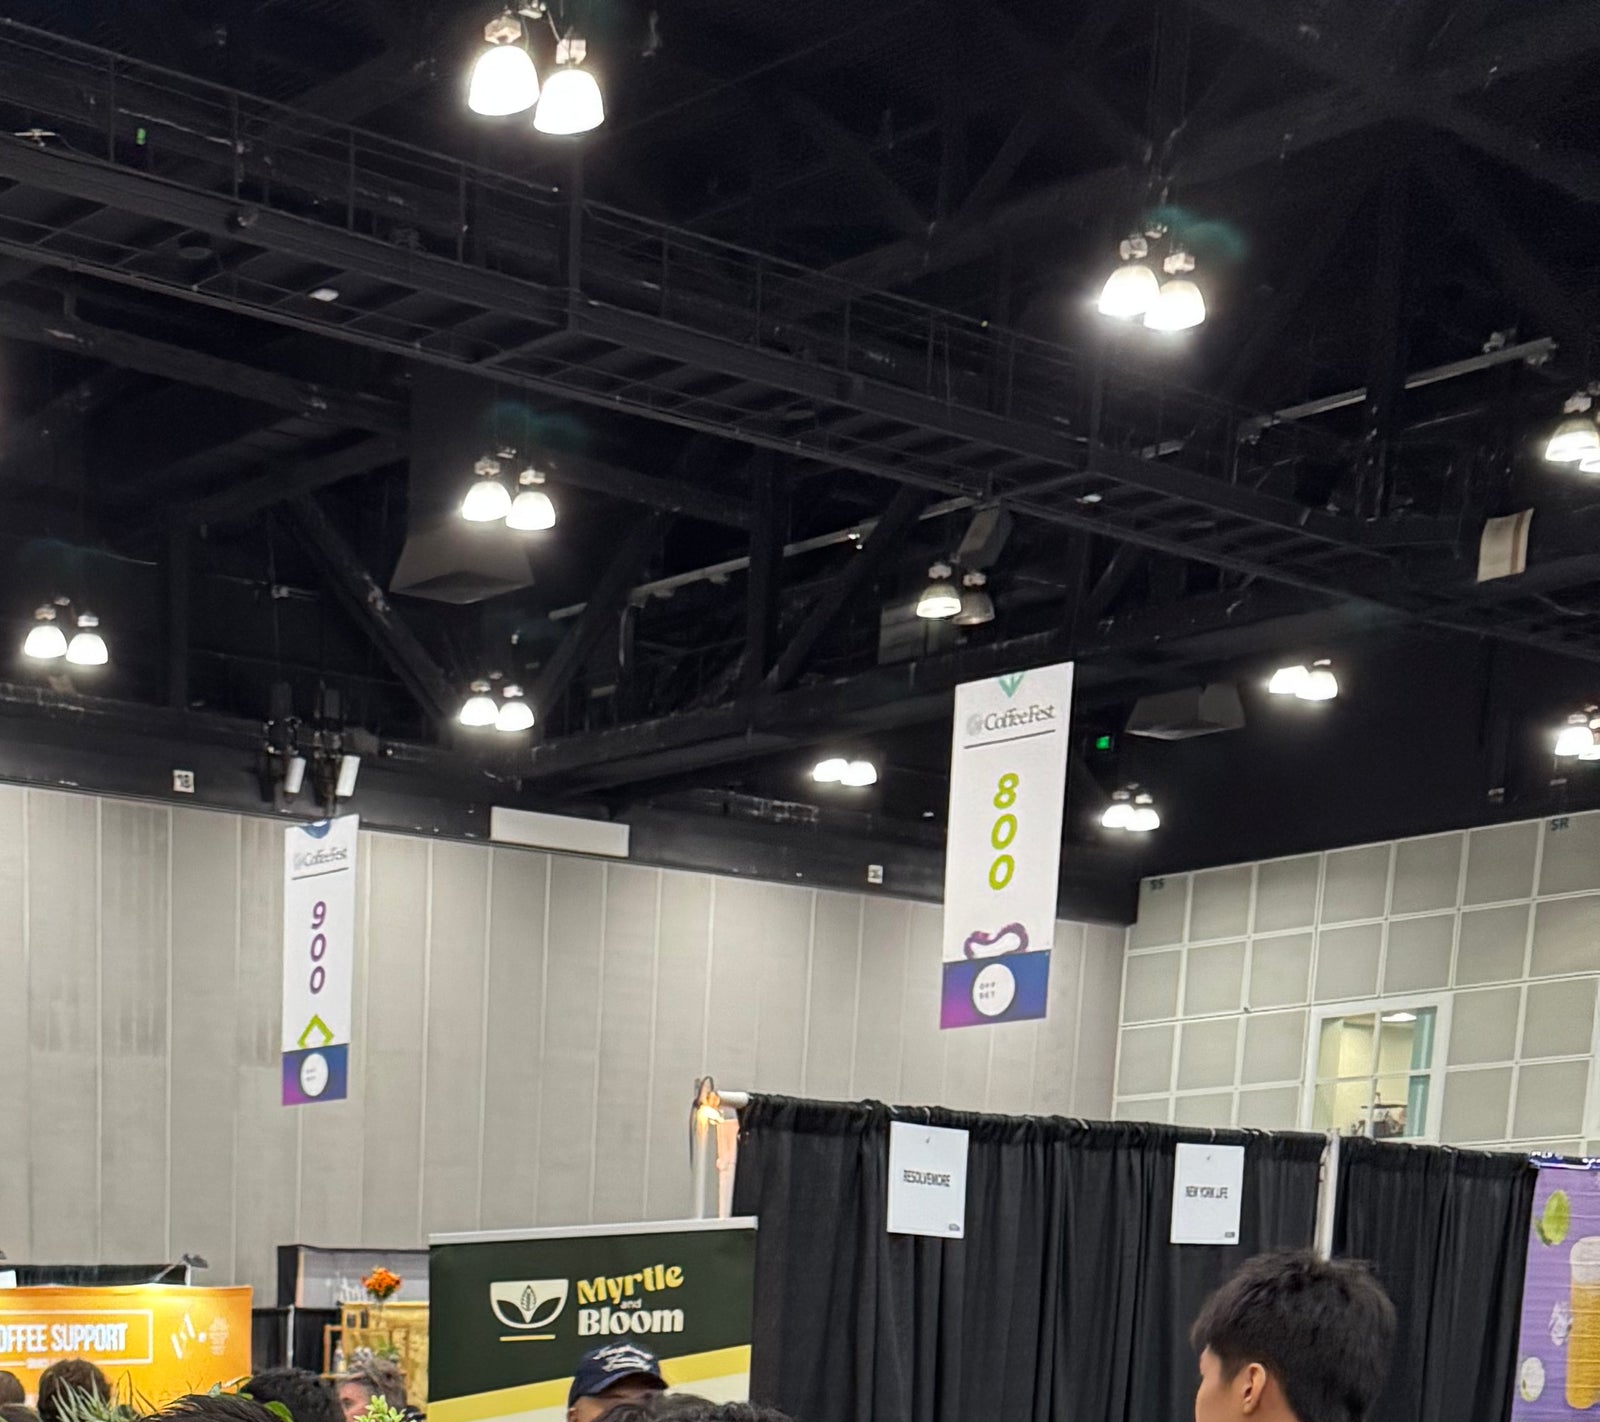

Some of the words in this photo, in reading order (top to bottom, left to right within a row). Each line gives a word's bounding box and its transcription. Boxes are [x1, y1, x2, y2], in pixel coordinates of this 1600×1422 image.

[576, 1263, 685, 1305] Myrtle
[620, 1298, 642, 1309] and
[577, 1308, 685, 1336] Bloom
[50, 1322, 128, 1353] SUPPORT
